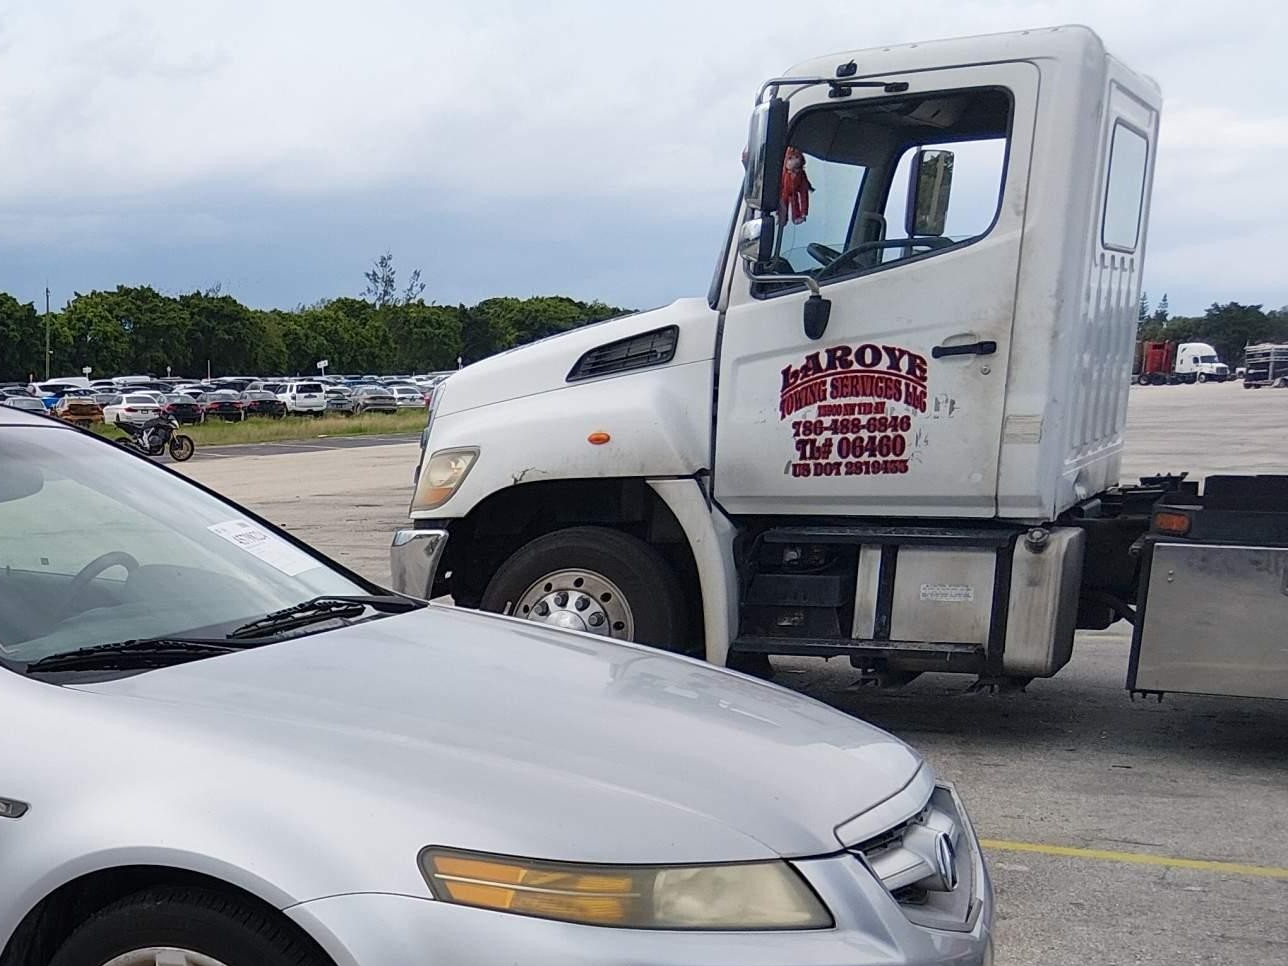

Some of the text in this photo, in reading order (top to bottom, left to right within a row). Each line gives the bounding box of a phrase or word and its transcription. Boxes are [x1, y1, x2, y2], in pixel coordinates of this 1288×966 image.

[779, 380, 828, 421] TOWING
[830, 375, 903, 402] SERVICES
[904, 382, 928, 413] LLC
[792, 415, 912, 437] 786-488-6846
[795, 434, 906, 461] TL# 06460
[792, 463, 811, 477] US
[813, 462, 842, 476] DOT
